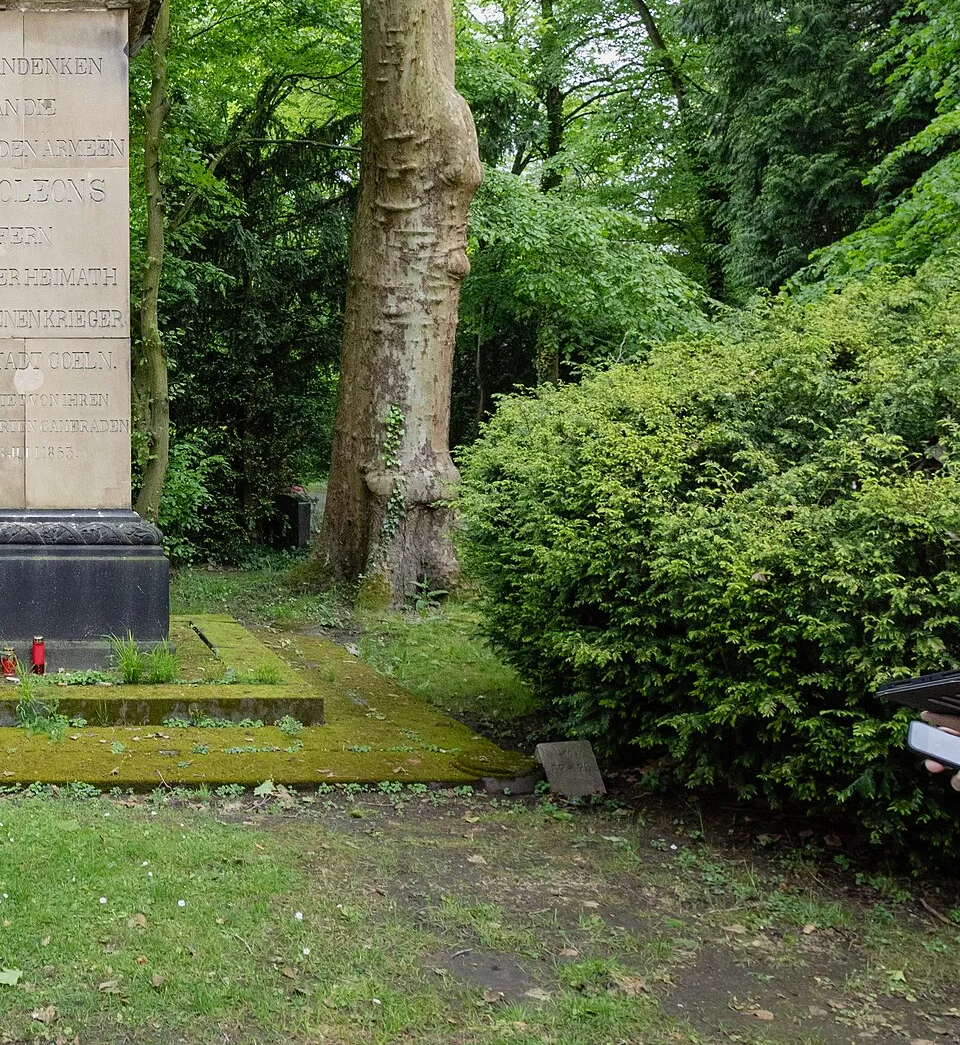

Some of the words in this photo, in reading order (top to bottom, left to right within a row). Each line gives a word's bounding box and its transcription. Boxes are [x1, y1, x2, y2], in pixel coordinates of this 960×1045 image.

[24, 98, 56, 116] DIE
[42, 138, 125, 158] ARMEEN
[24, 267, 118, 287] HEIMATH
[43, 309, 126, 329] KRIEGER
[62, 393, 109, 407] IHREN
